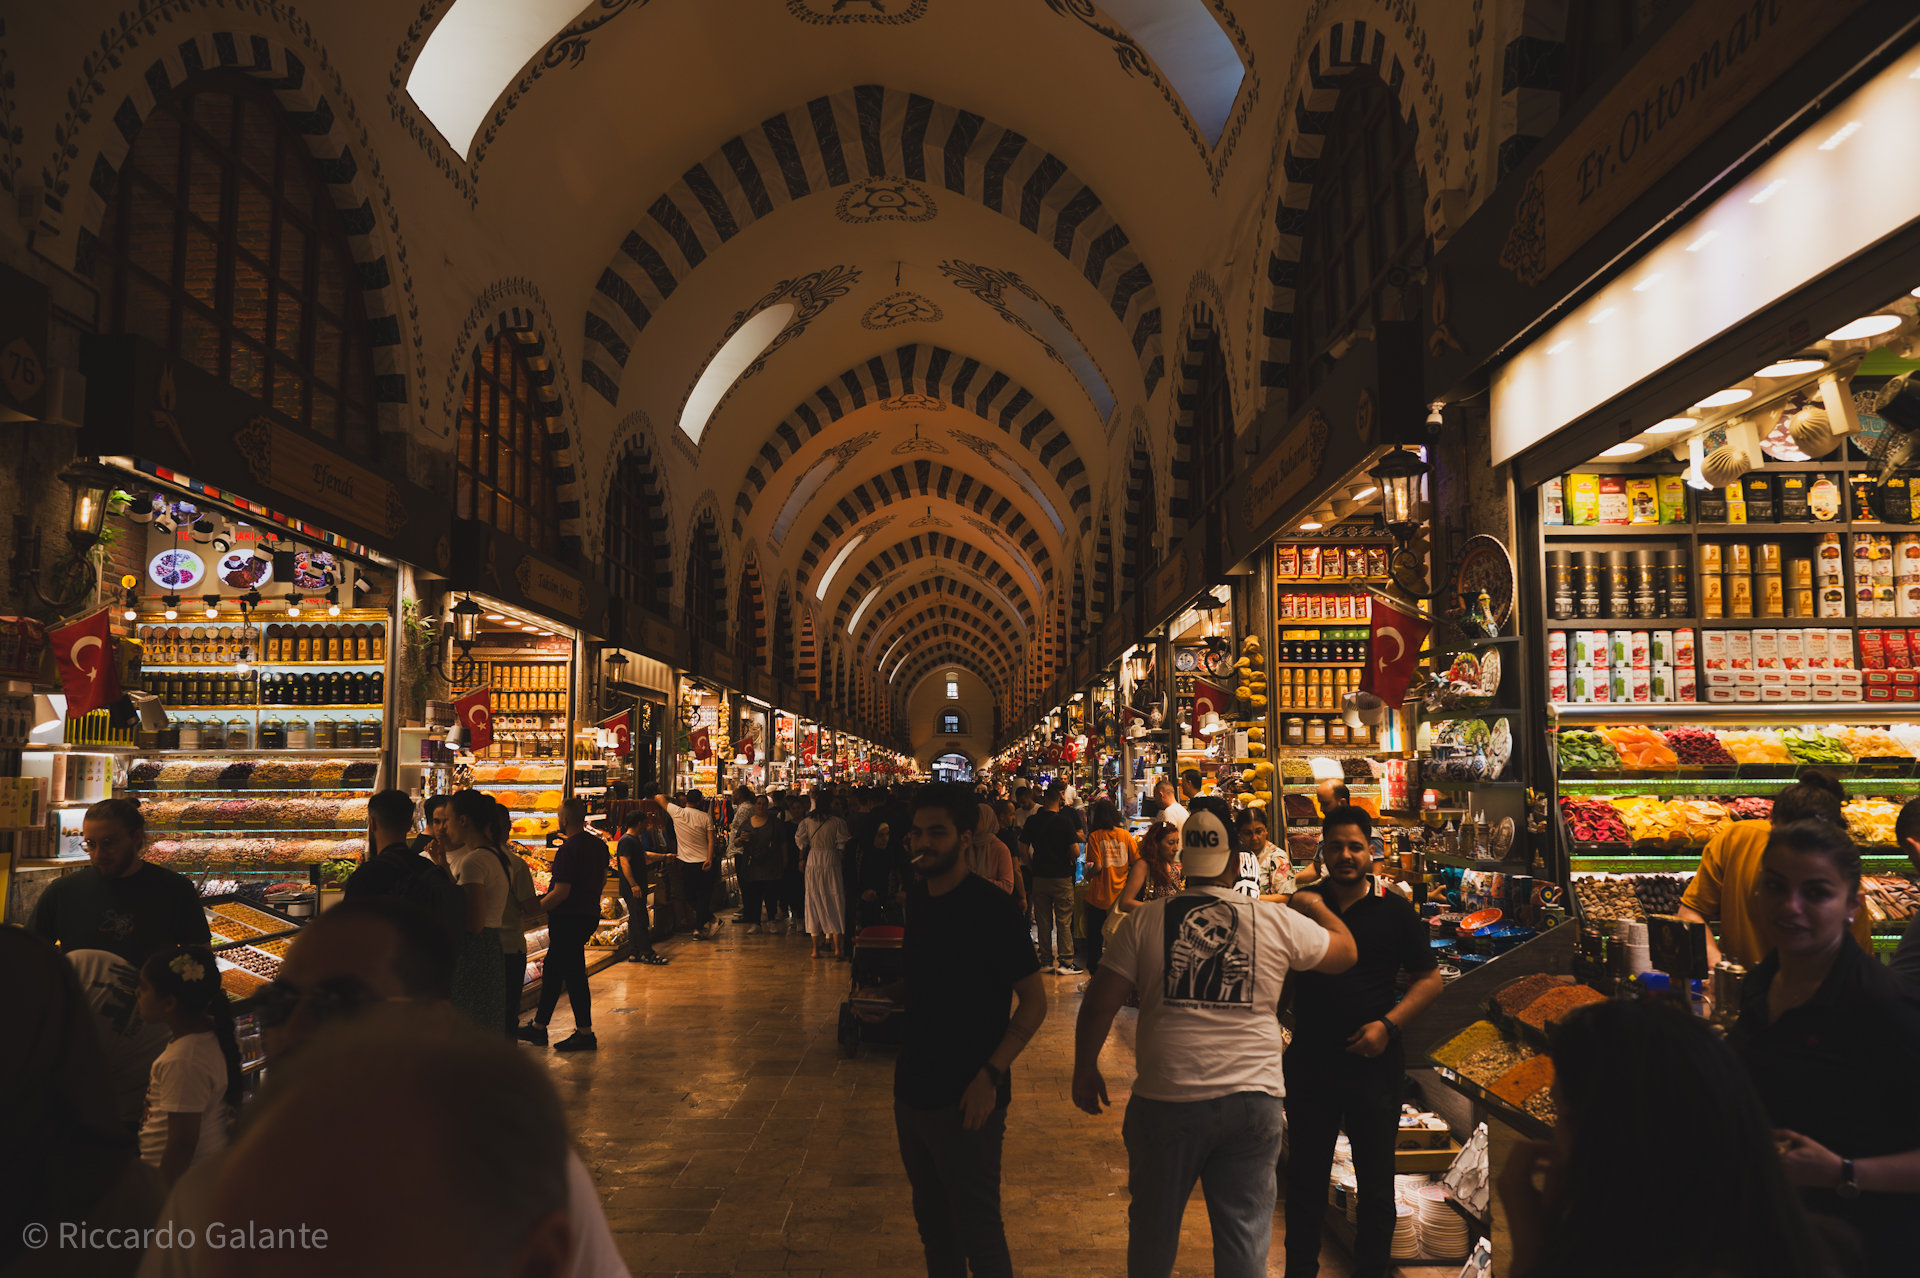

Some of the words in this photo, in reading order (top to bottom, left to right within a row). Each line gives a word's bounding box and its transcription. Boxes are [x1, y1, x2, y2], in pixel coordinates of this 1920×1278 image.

[9, 350, 35, 385] 76
[1358, 400, 1369, 430] 67
[312, 463, 354, 499] Efendi
[177, 531, 193, 541] TE
[538, 573, 559, 594] Taksim
[559, 583, 573, 602] Spice
[1185, 830, 1219, 848] KING
[1163, 999, 1199, 1010] choosing
